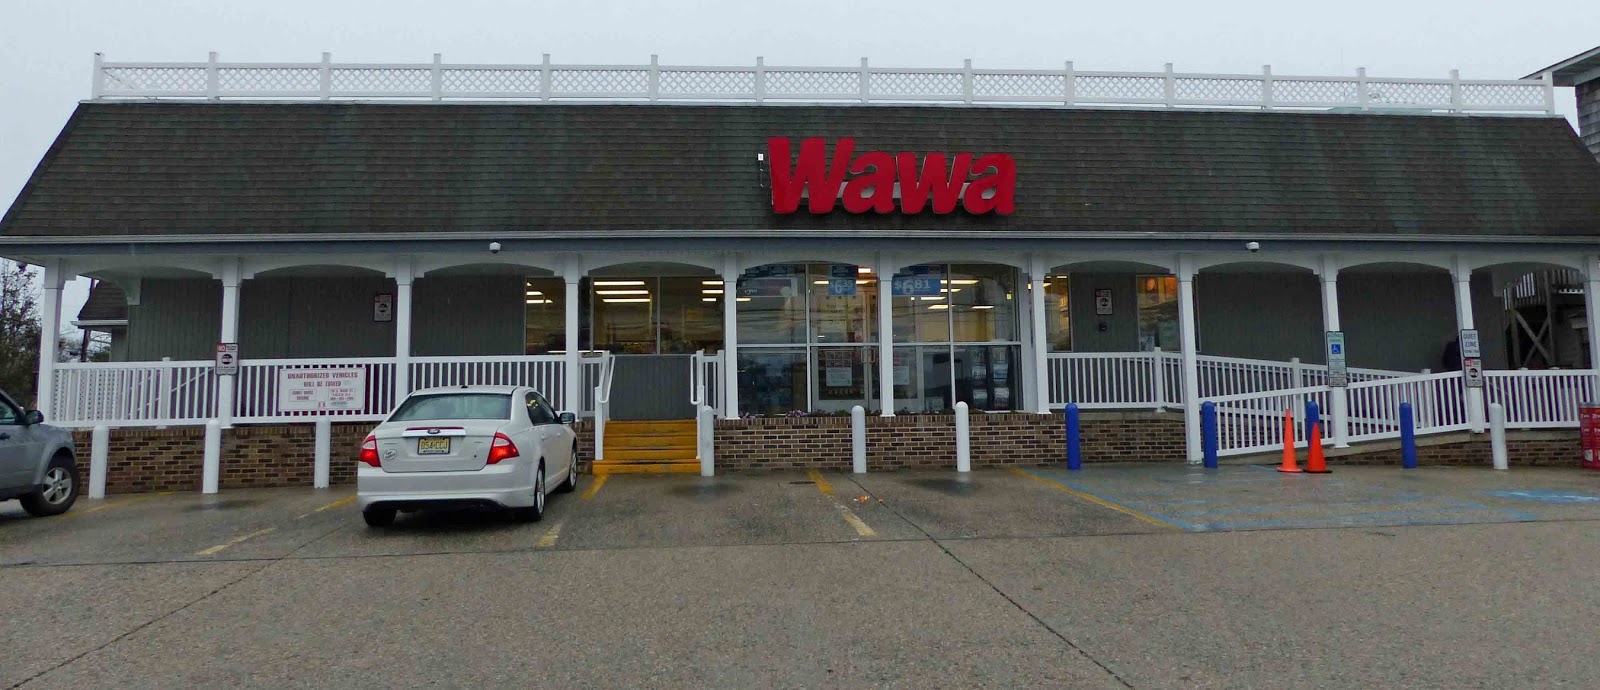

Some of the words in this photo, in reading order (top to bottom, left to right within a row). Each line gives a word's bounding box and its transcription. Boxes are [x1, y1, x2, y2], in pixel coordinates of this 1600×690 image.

[768, 136, 1016, 214] Wawa
[894, 279, 931, 296] $681
[287, 372, 330, 380] UNAUTHORIZED
